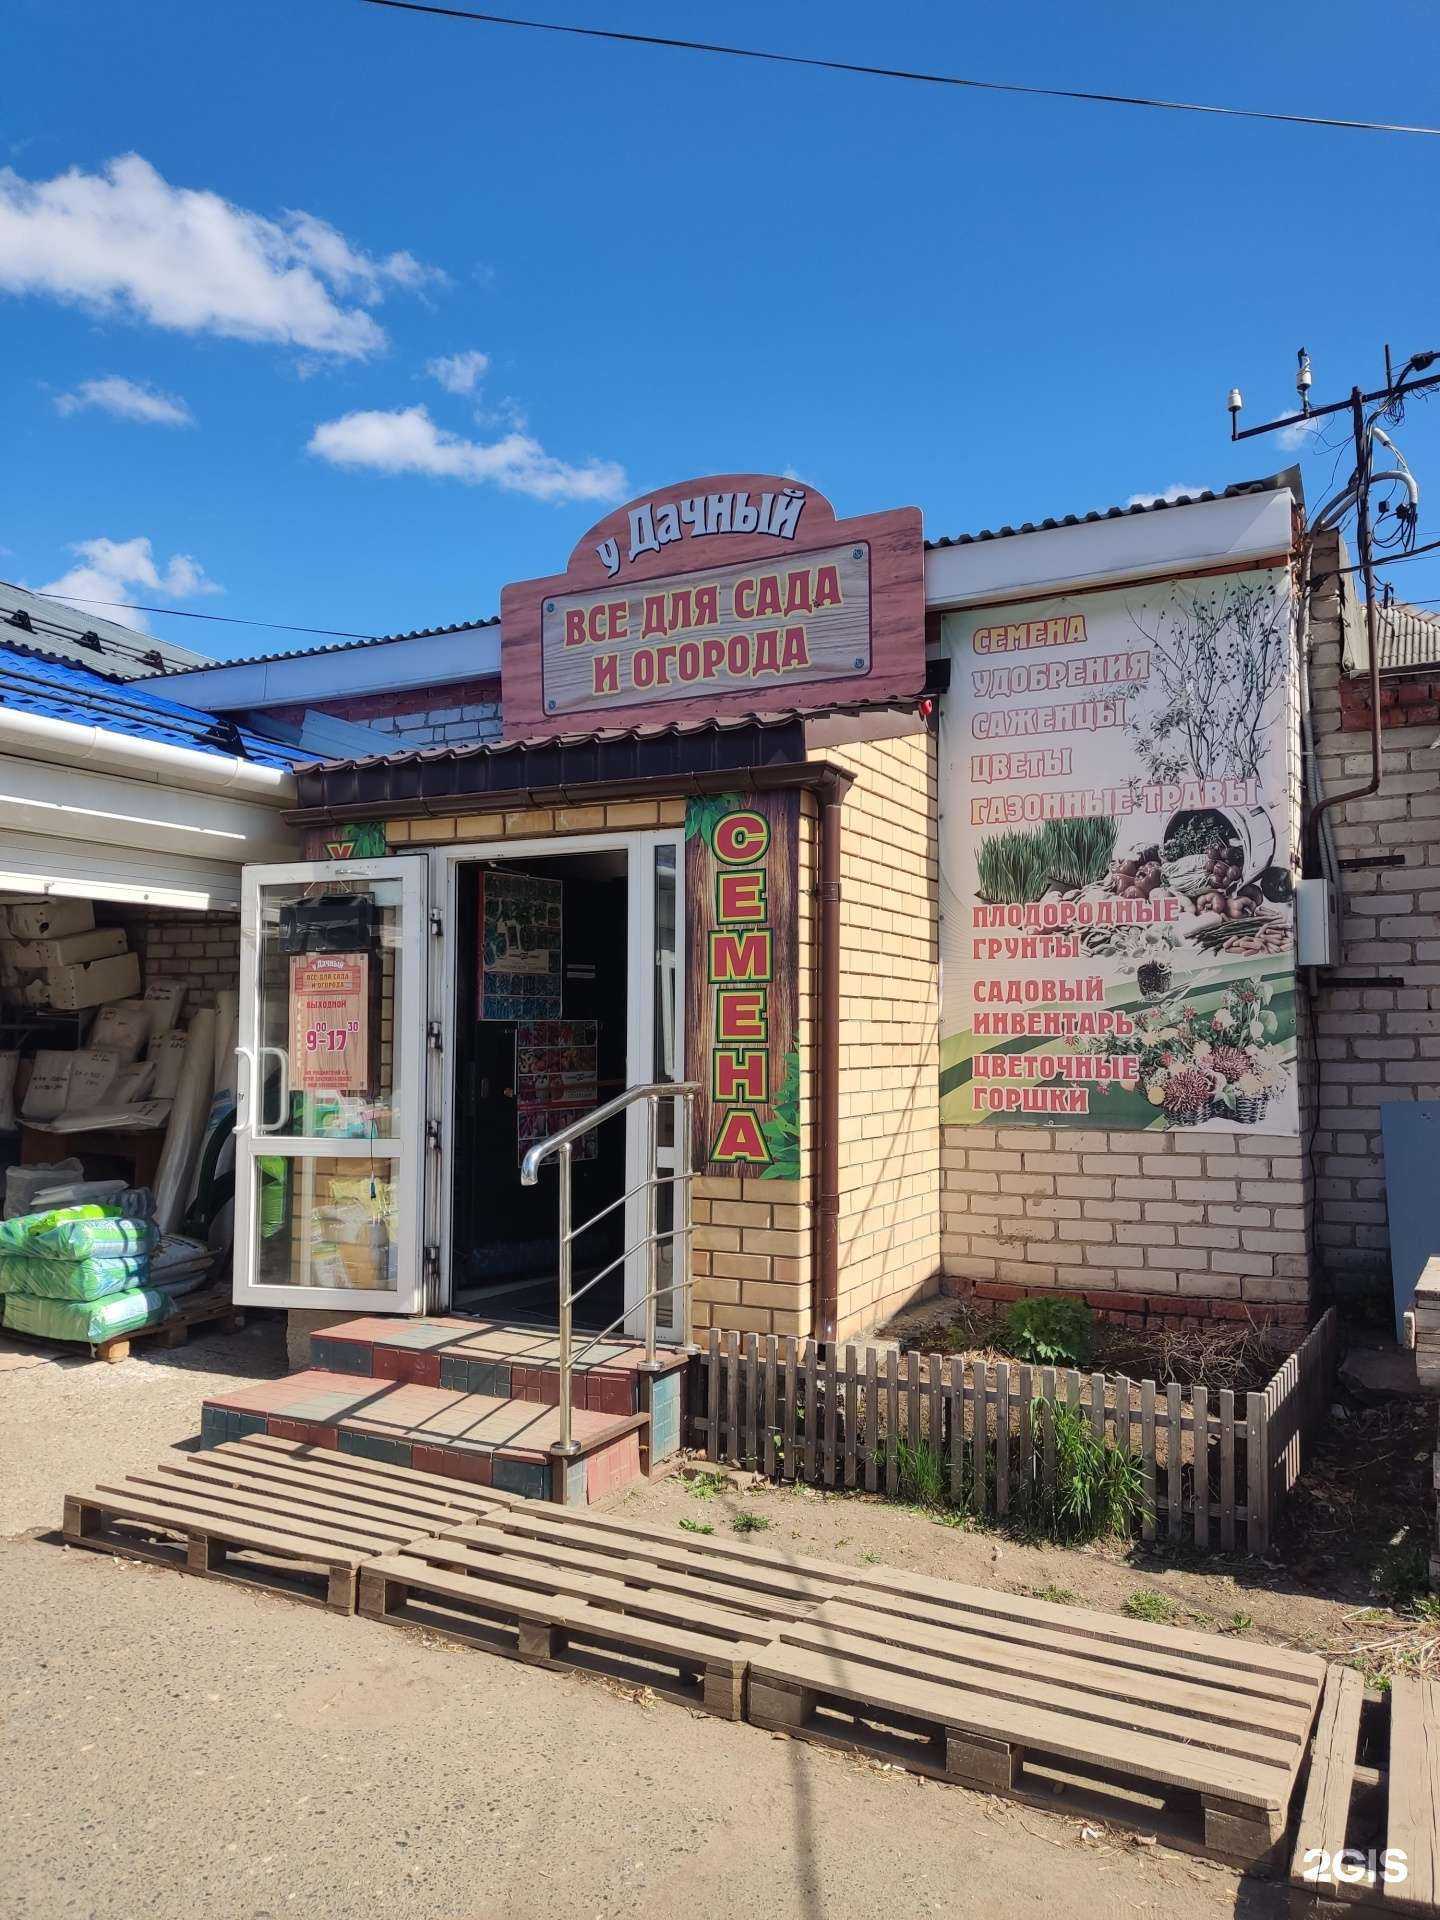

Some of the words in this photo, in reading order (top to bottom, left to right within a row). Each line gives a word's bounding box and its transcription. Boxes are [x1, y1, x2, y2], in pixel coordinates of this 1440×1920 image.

[564, 599, 629, 648] ВСЕ
[641, 584, 720, 640] ДЛЯ
[733, 563, 843, 619] САДА
[971, 615, 1087, 655] СЕМЕНА
[592, 651, 620, 696] И
[632, 625, 810, 689] ОГОРОДА
[972, 651, 1150, 699] УДОБРЕНИЯ
[972, 699, 1126, 740] САЖЕНЦЫ
[971, 748, 1072, 784] ЦВЕТЫ
[971, 787, 1134, 825] ГАЗОННЫЕ
[1144, 778, 1257, 813] ТРАВЫ
[971, 899, 1181, 928] ПЛОДОРОДНЫЕ
[971, 933, 1080, 960] ГРУНТЫ
[708, 809, 775, 1165] СЕМЕНА
[973, 975, 1105, 1005] САДОВЫЙ
[972, 1011, 1135, 1037] ИНВЕНТАРЬ
[971, 1054, 1140, 1082] ЦВЕТОЧНЫЕ
[971, 1087, 1089, 1113] ГОРШКИ
